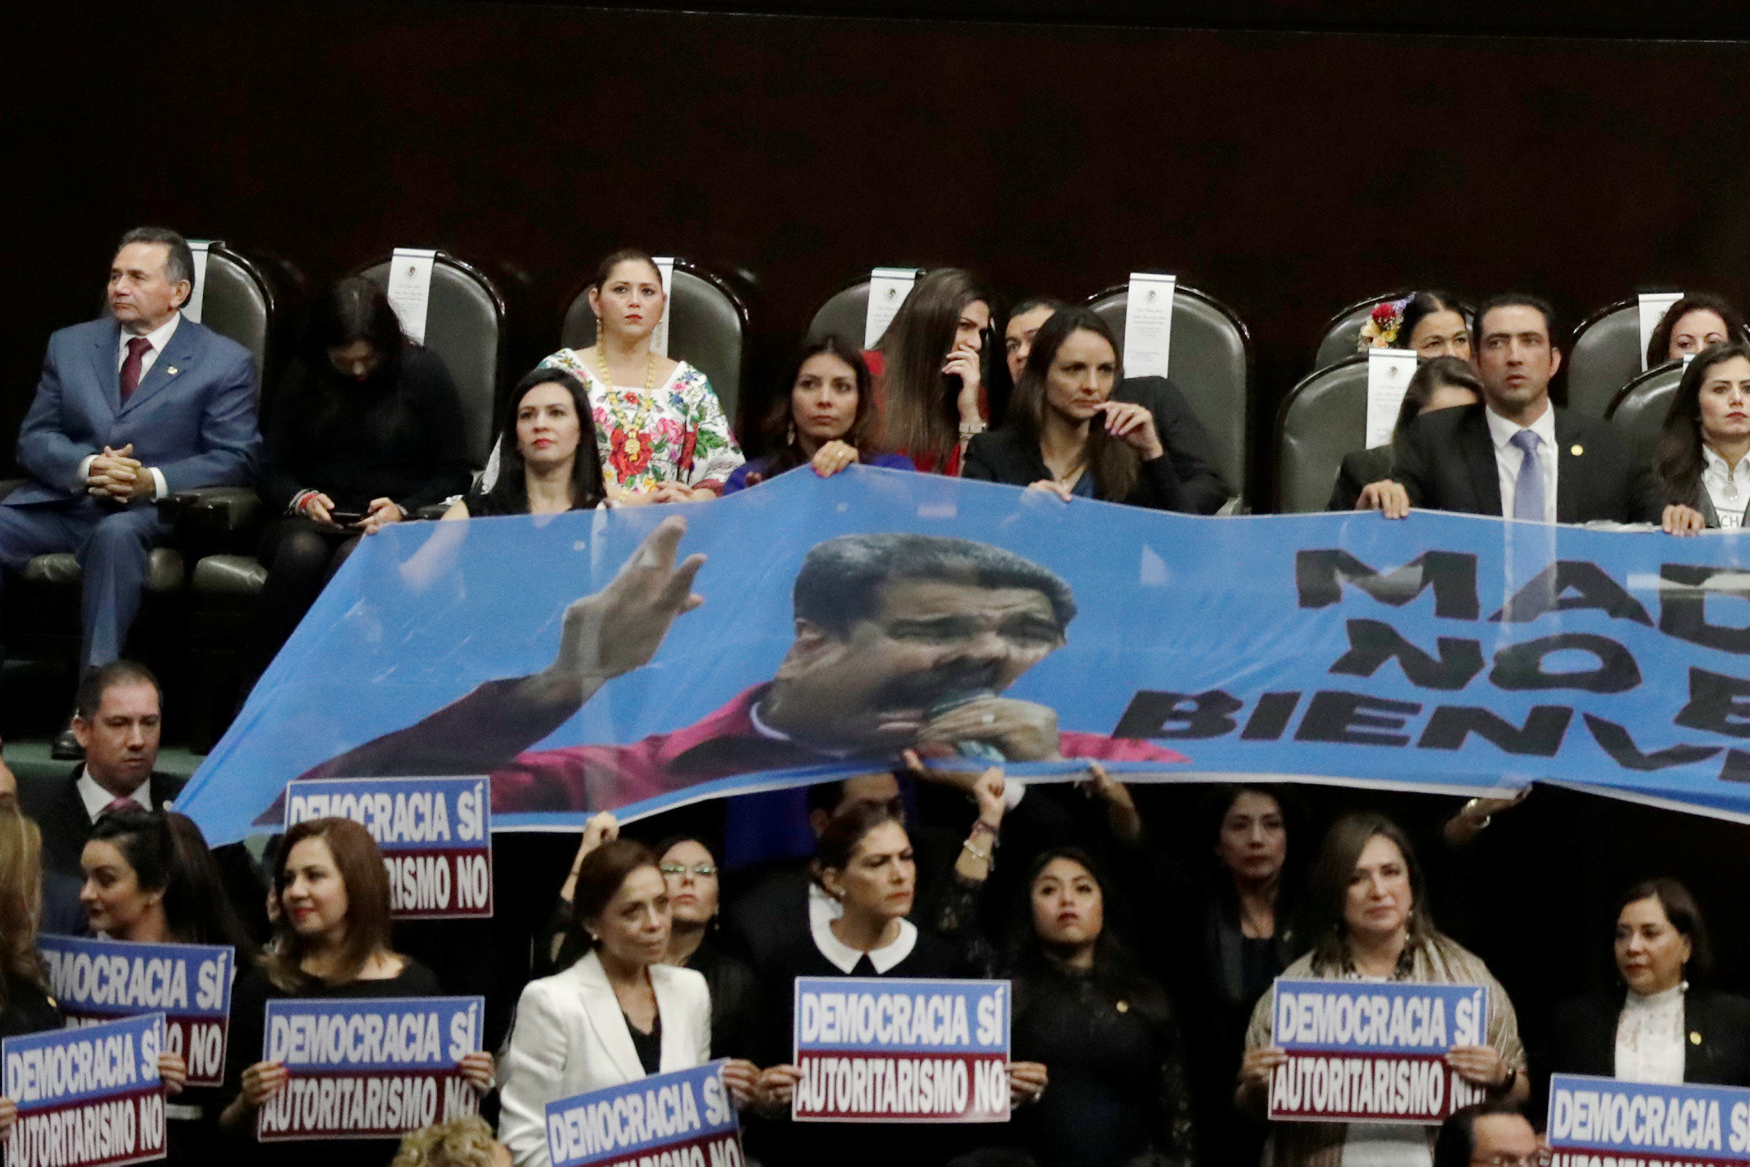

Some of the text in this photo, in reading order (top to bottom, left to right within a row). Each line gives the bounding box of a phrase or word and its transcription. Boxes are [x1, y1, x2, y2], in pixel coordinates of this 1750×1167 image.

[1328, 619, 1642, 693] NO
[457, 781, 484, 841] SÍ
[457, 854, 488, 909] NO
[43, 949, 228, 1010] MOCRACIA SÍ
[269, 1001, 478, 1065] DEMOCRACIA SÍ
[801, 986, 1005, 1046] DEMOCRACIA SÍ
[1277, 988, 1482, 1047] DEMOCRACIA SÍ
[7, 1033, 136, 1102] DEMOCRACIA
[141, 1018, 161, 1082] SÍ
[188, 1023, 222, 1077] NO
[262, 1076, 437, 1132] AUTORITARISMO
[549, 1065, 731, 1164] DEMOCRACIA SÍ
[796, 1056, 1005, 1114] AUTORITARISMO NO
[1272, 1057, 1444, 1116] AUTORITARISMO
[8, 1093, 163, 1167] AUTORITARISMO NO
[1552, 1089, 1722, 1151] DEMOCRACIA
